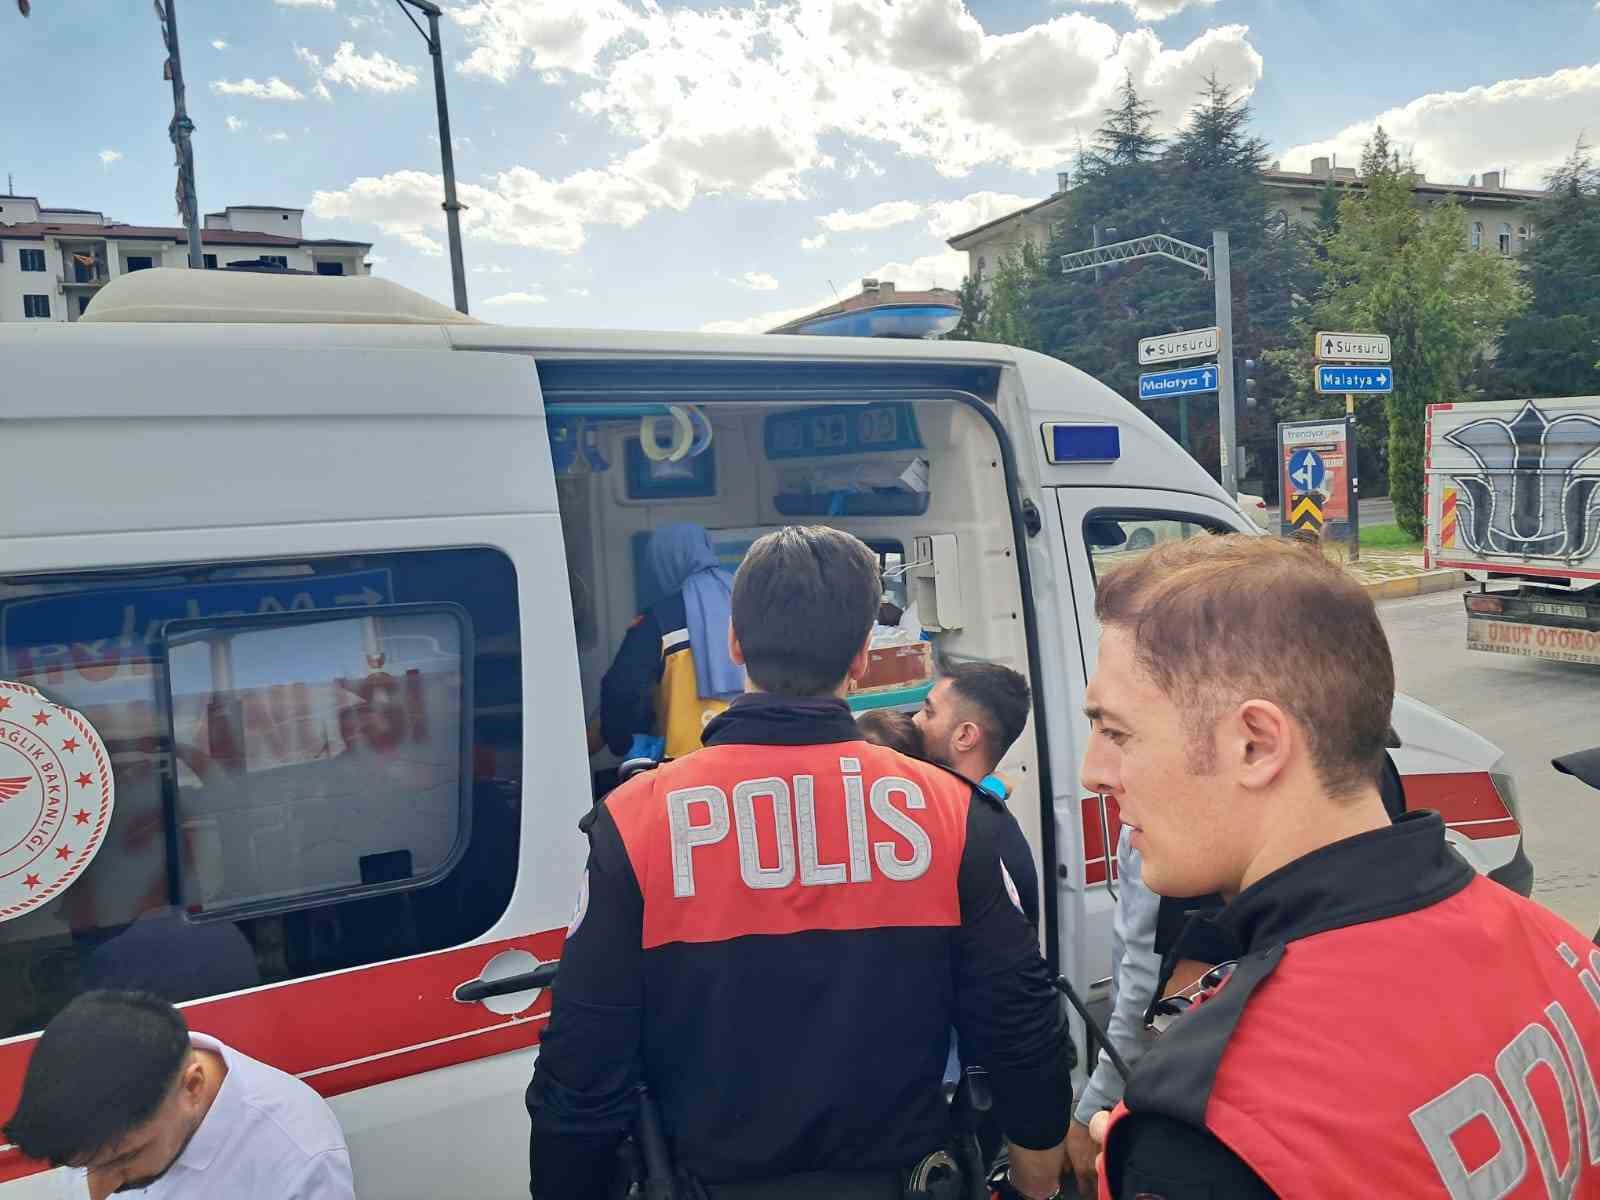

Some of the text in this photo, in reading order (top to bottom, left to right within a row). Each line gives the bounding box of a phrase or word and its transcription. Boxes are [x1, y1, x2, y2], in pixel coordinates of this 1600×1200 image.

[1142, 376, 1198, 393] Malatya
[1323, 373, 1373, 387] Malatya
[1488, 623, 1533, 645] UMUT
[0, 727, 61, 852] AĞLIK BAKANLIĞI
[666, 757, 932, 897] POLİS
[1408, 942, 1600, 1200] POLİ
